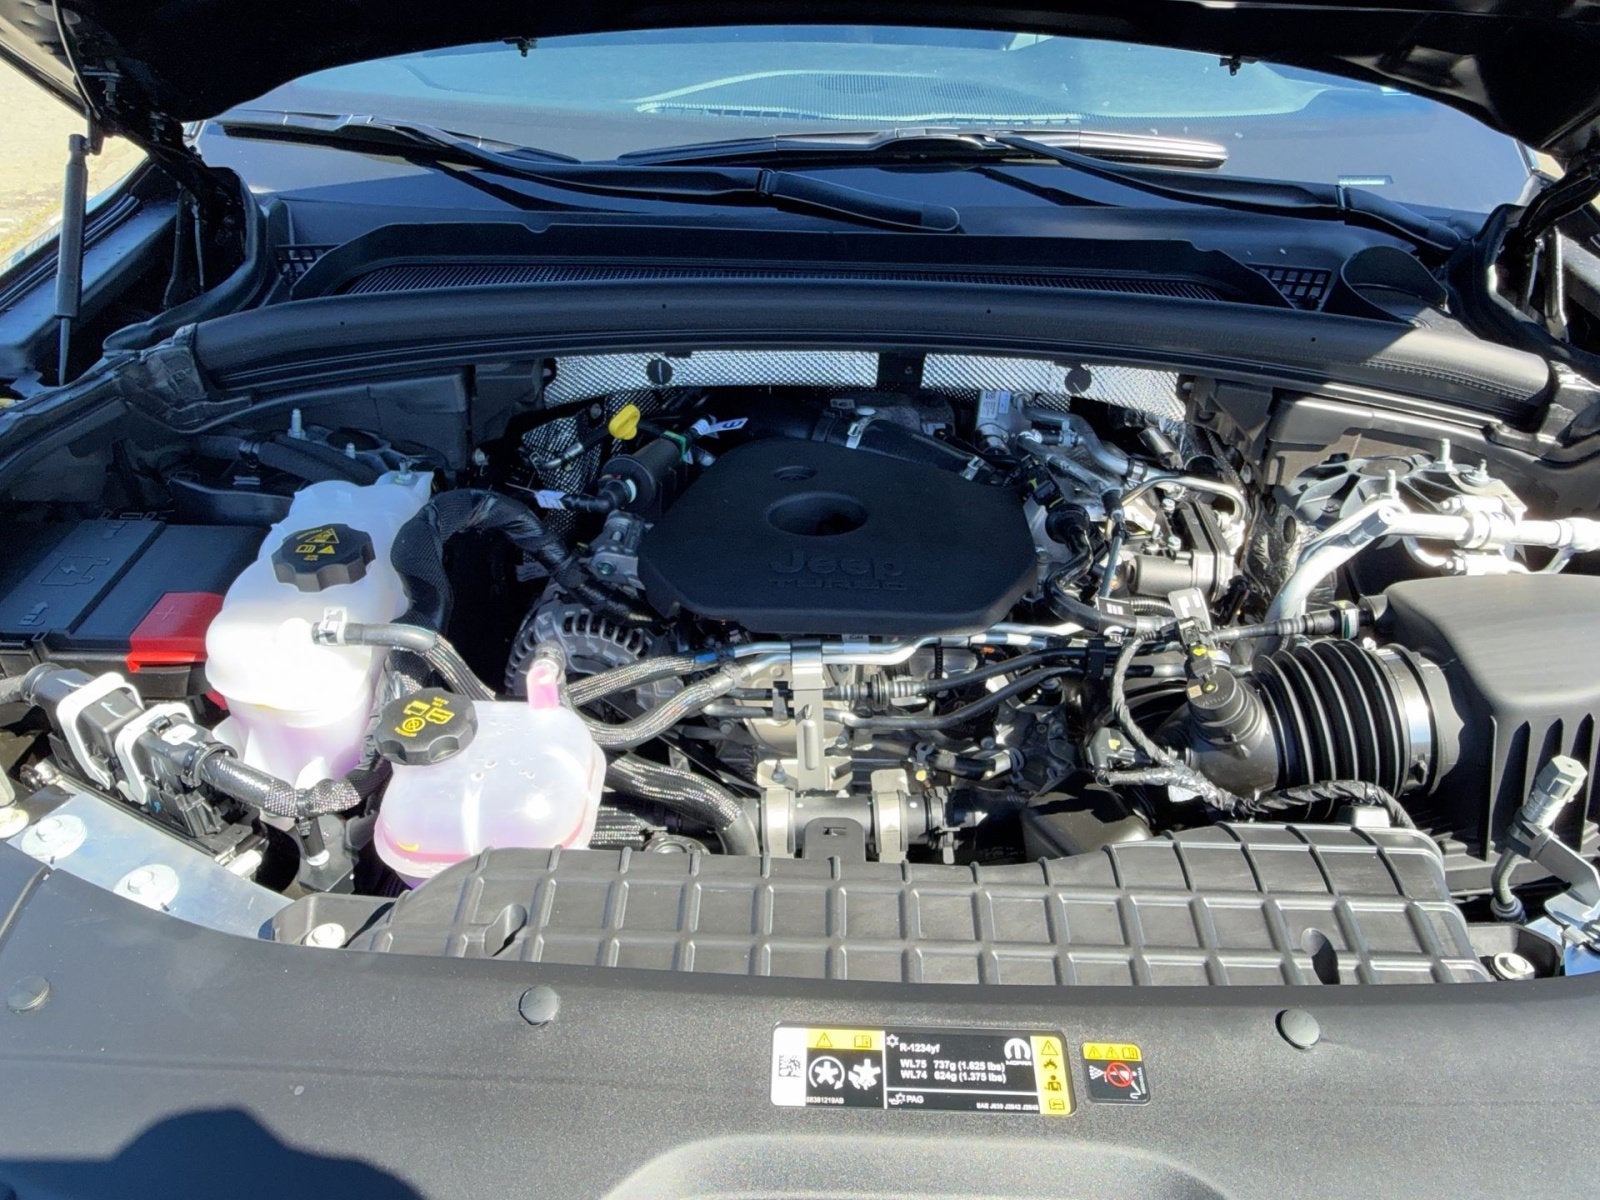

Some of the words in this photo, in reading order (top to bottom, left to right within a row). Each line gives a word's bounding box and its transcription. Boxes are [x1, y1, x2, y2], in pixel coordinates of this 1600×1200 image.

[768, 549, 905, 579] Jeep
[899, 1043, 941, 1055] R-1234yf
[900, 1059, 928, 1069] WL75
[933, 1060, 957, 1072] 737g
[987, 1061, 1007, 1073] lbs)
[900, 1070, 928, 1080] WL74
[934, 1071, 958, 1083] 624g
[988, 1072, 1008, 1084] lbs)
[906, 1095, 925, 1104] PAG
